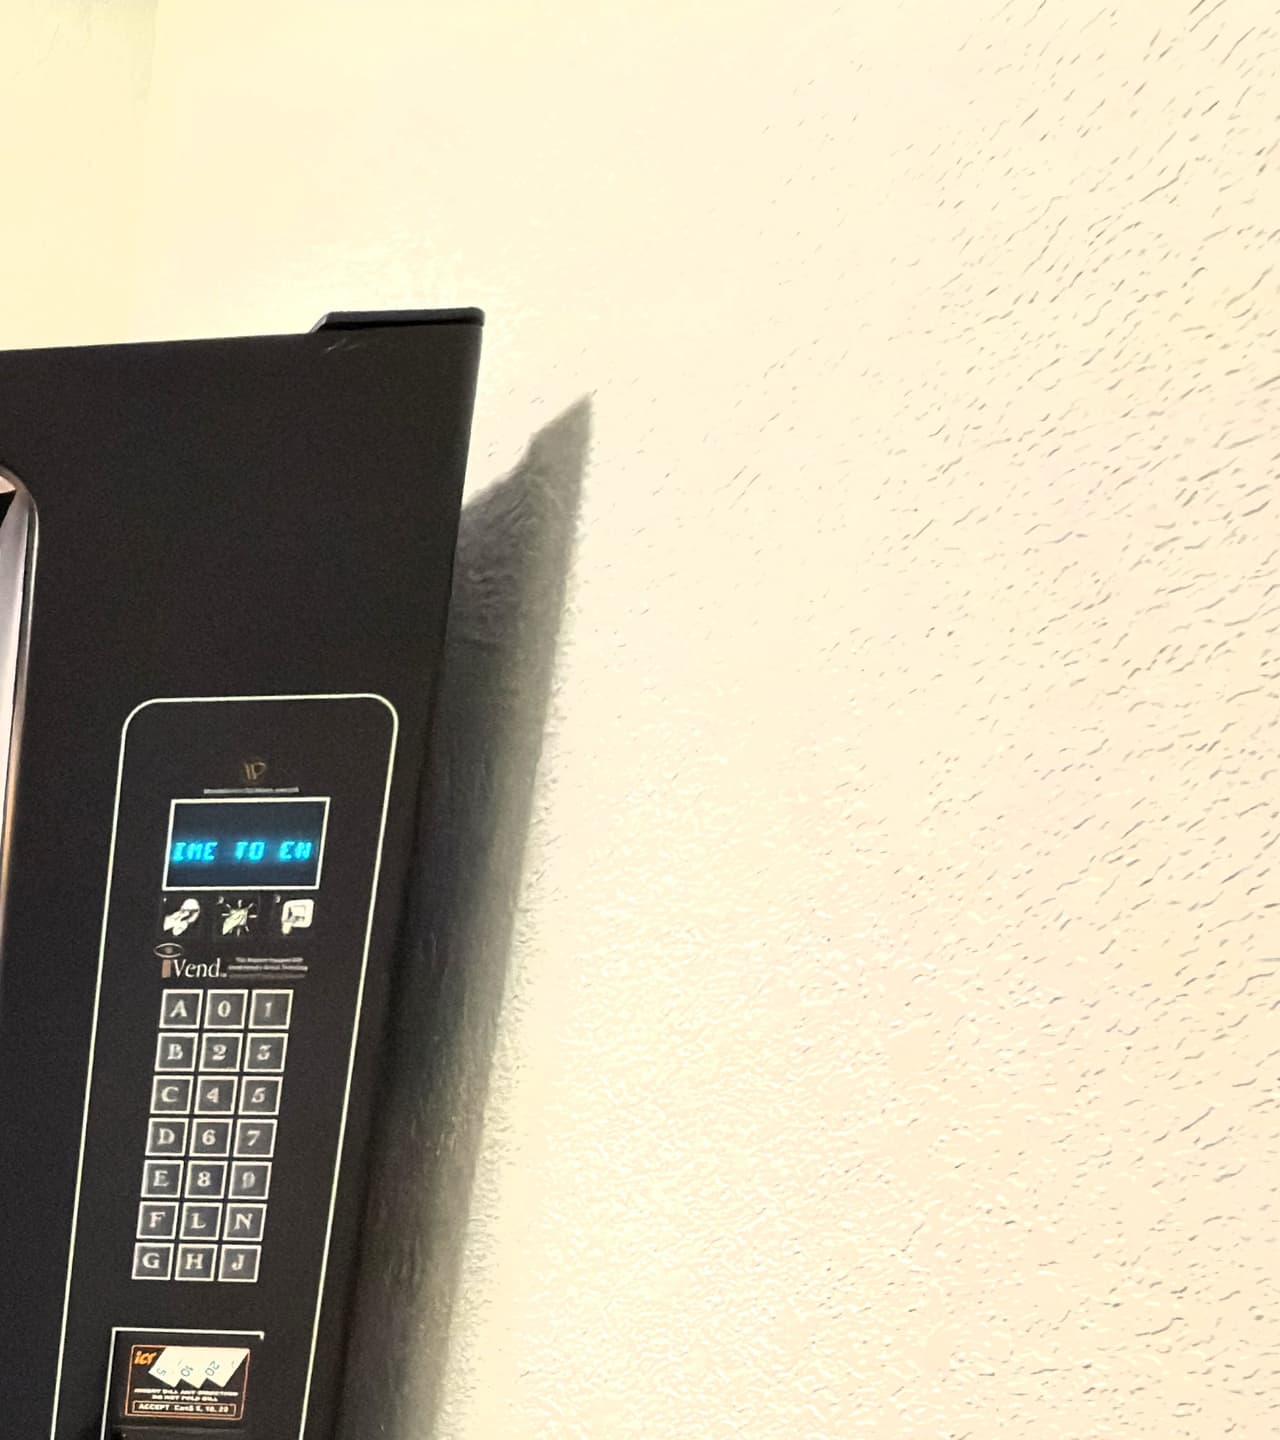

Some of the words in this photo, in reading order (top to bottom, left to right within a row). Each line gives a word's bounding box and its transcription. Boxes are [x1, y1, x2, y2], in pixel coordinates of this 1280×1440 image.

[234, 841, 266, 861] TO
[170, 999, 188, 1018] A
[217, 1001, 231, 1018] 0
[263, 1002, 273, 1018] 1
[167, 1043, 184, 1060] B
[212, 1044, 227, 1061] 2
[256, 1044, 271, 1061] 3
[160, 1086, 180, 1103] C
[206, 1087, 220, 1102] 4
[251, 1087, 266, 1103] 5
[157, 1128, 175, 1145] D
[202, 1129, 216, 1146] 6
[246, 1130, 261, 1146] 7
[153, 1170, 170, 1187] E
[197, 1171, 211, 1187] 8
[149, 1211, 165, 1228] F
[191, 1212, 206, 1229] L
[233, 1212, 255, 1230] N
[142, 1252, 160, 1269] G
[185, 1253, 204, 1270] H
[231, 1254, 246, 1270] J
[204, 1360, 221, 1377] 20
[138, 1402, 171, 1411] ACCEPT
